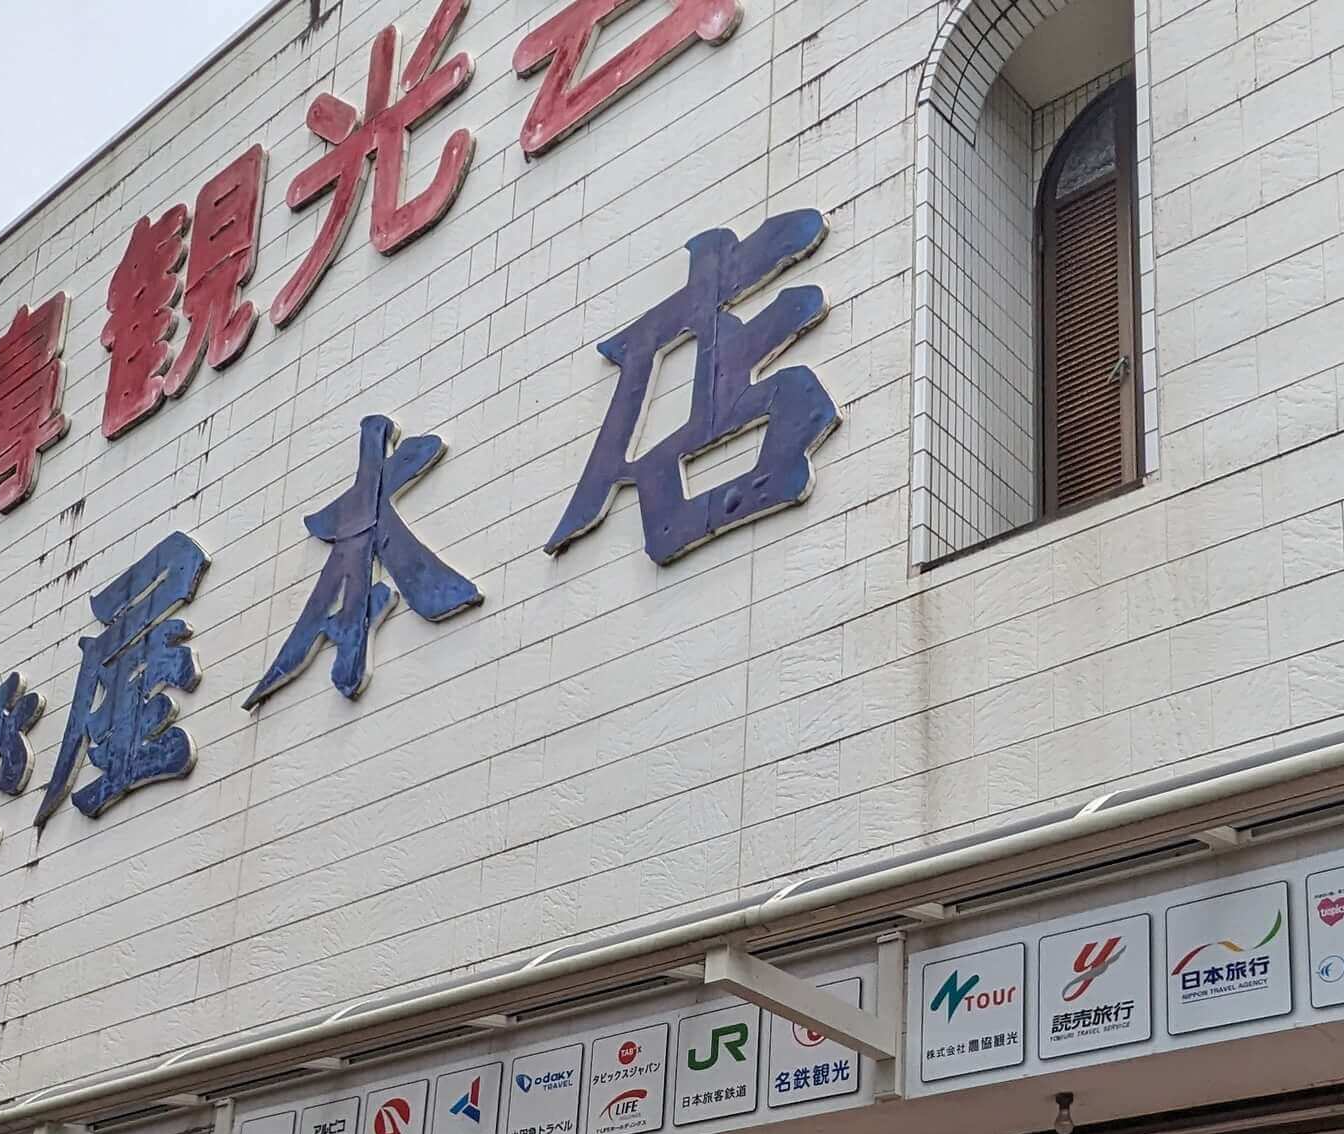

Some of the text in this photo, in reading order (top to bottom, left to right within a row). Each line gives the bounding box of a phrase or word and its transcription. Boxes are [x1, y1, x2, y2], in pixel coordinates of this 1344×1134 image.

[1181, 955, 1270, 991] 日本旅行
[1210, 984, 1236, 995] TRAVEL
[1238, 978, 1269, 990] AGENCY
[1051, 1000, 1135, 1034] 読売旅行
[687, 1022, 749, 1071] JR
[543, 1079, 574, 1092] TRAVEL
[592, 1061, 661, 1086] タビックスジャパン
[774, 1059, 851, 1094] 名鉄観光
[615, 1099, 639, 1116] LIFE
[682, 1084, 747, 1110] 日本旅客鉄道
